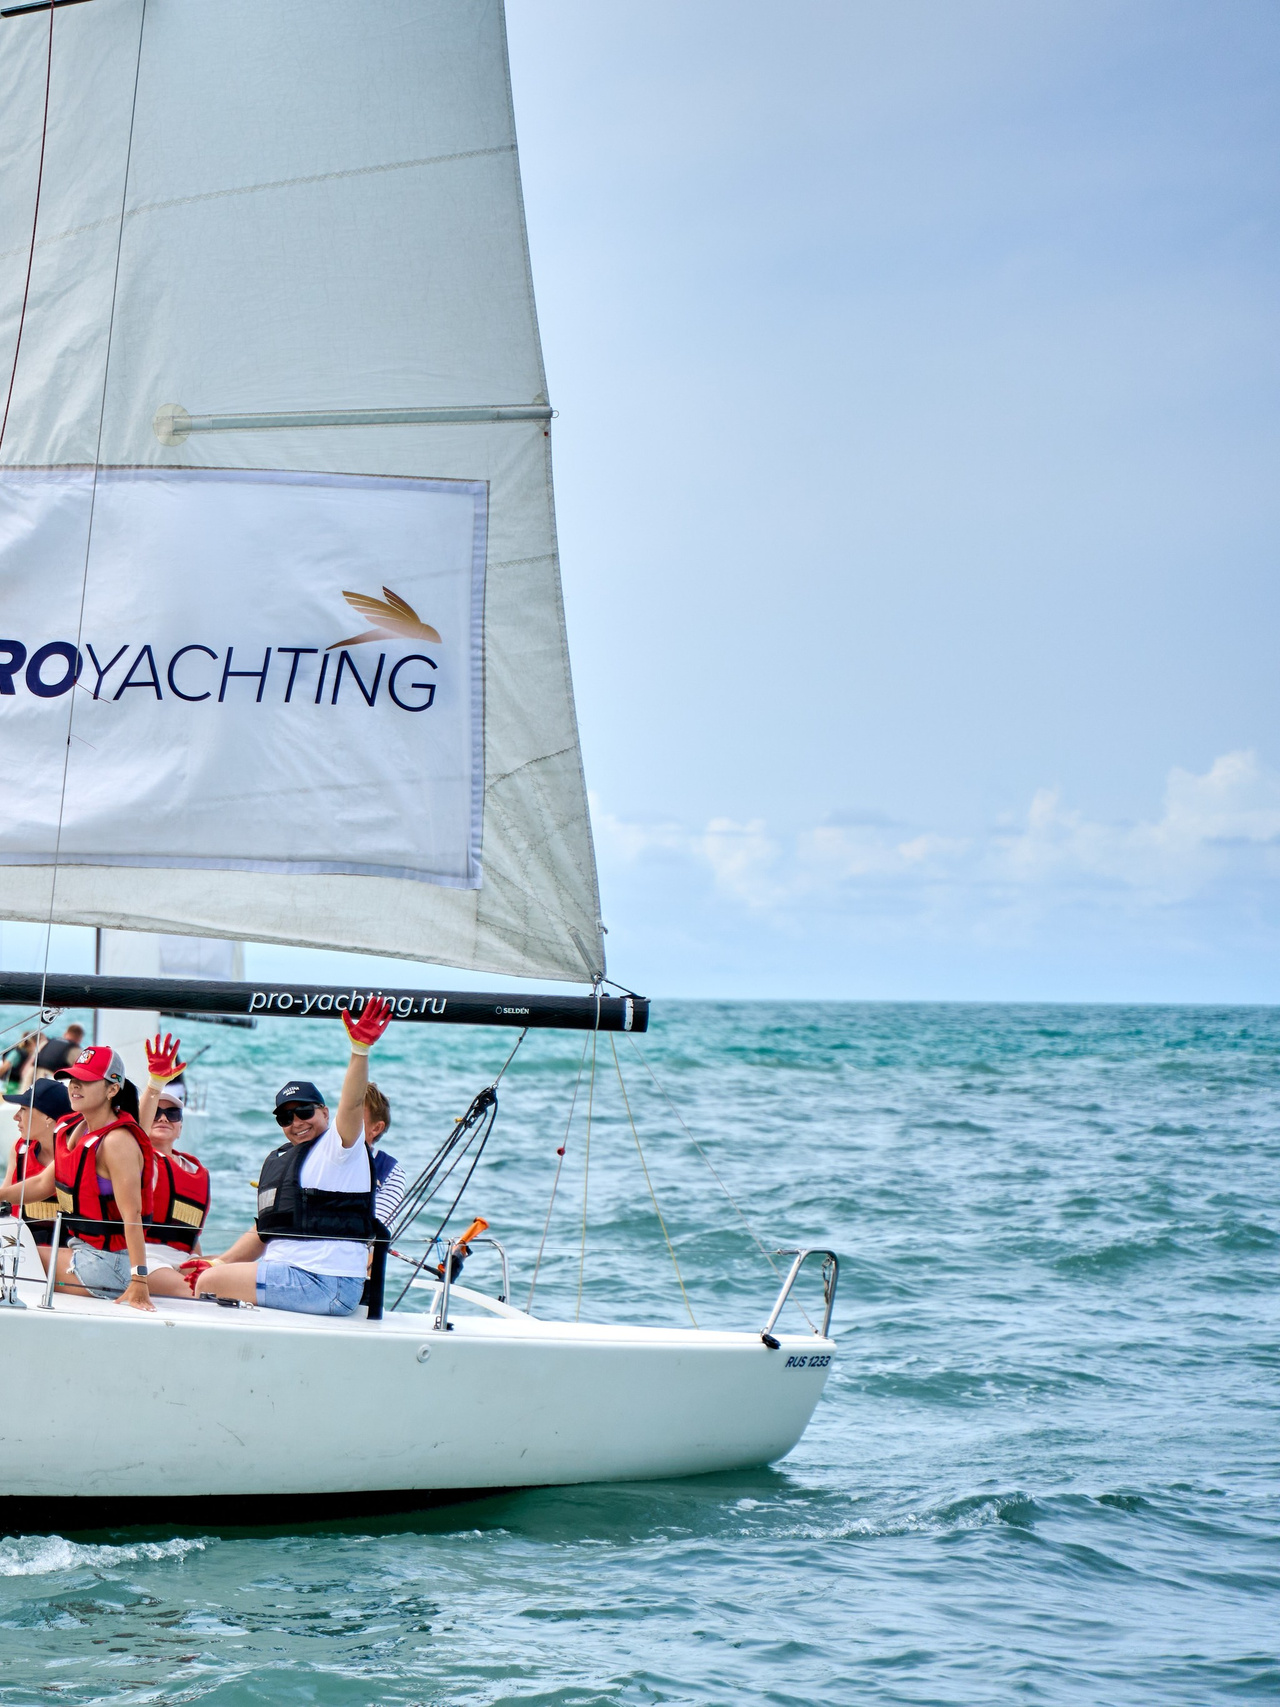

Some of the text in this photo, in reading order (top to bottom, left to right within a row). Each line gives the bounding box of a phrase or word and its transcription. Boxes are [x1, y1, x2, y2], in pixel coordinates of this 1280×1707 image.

[249, 990, 447, 1018] pro-yachting.ru
[785, 1355, 831, 1368] RUS 1233
